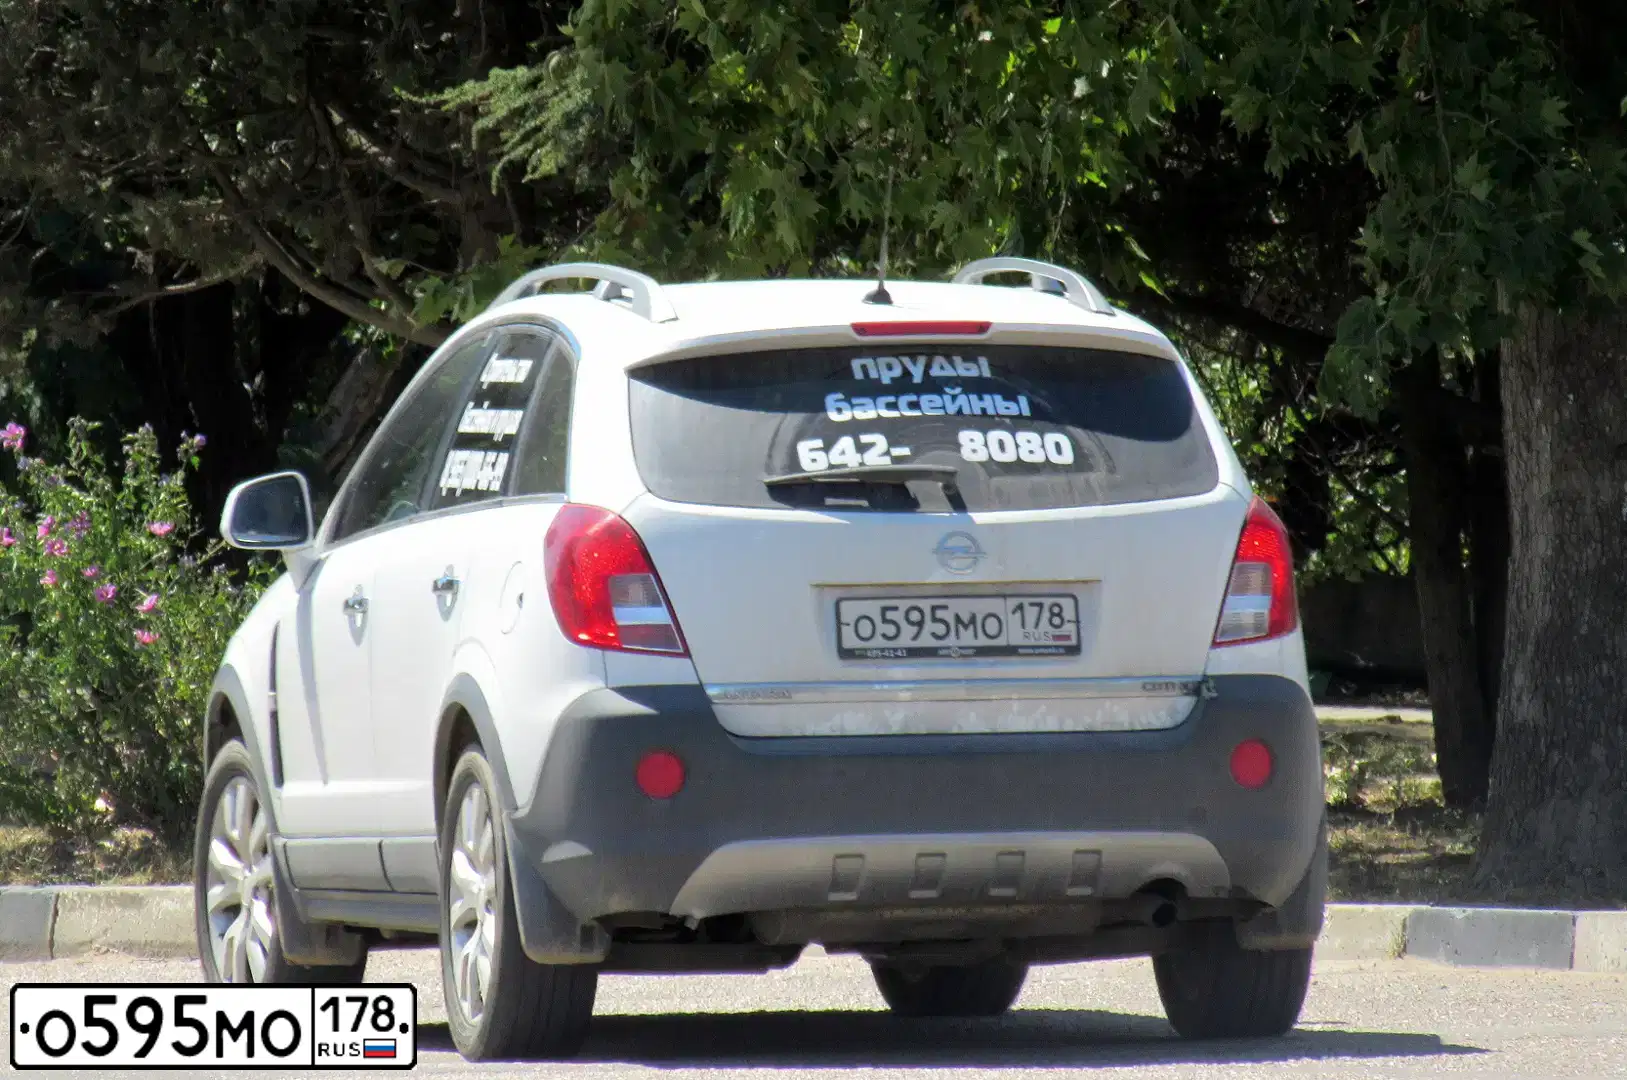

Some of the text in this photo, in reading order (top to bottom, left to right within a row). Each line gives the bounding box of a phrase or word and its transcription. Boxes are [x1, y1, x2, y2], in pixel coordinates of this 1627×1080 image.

[851, 355, 992, 384] пруды
[824, 387, 1031, 422] бассейны
[958, 430, 1074, 465] 8080
[1011, 602, 1065, 630] 178
[1023, 631, 1050, 642] RUS
